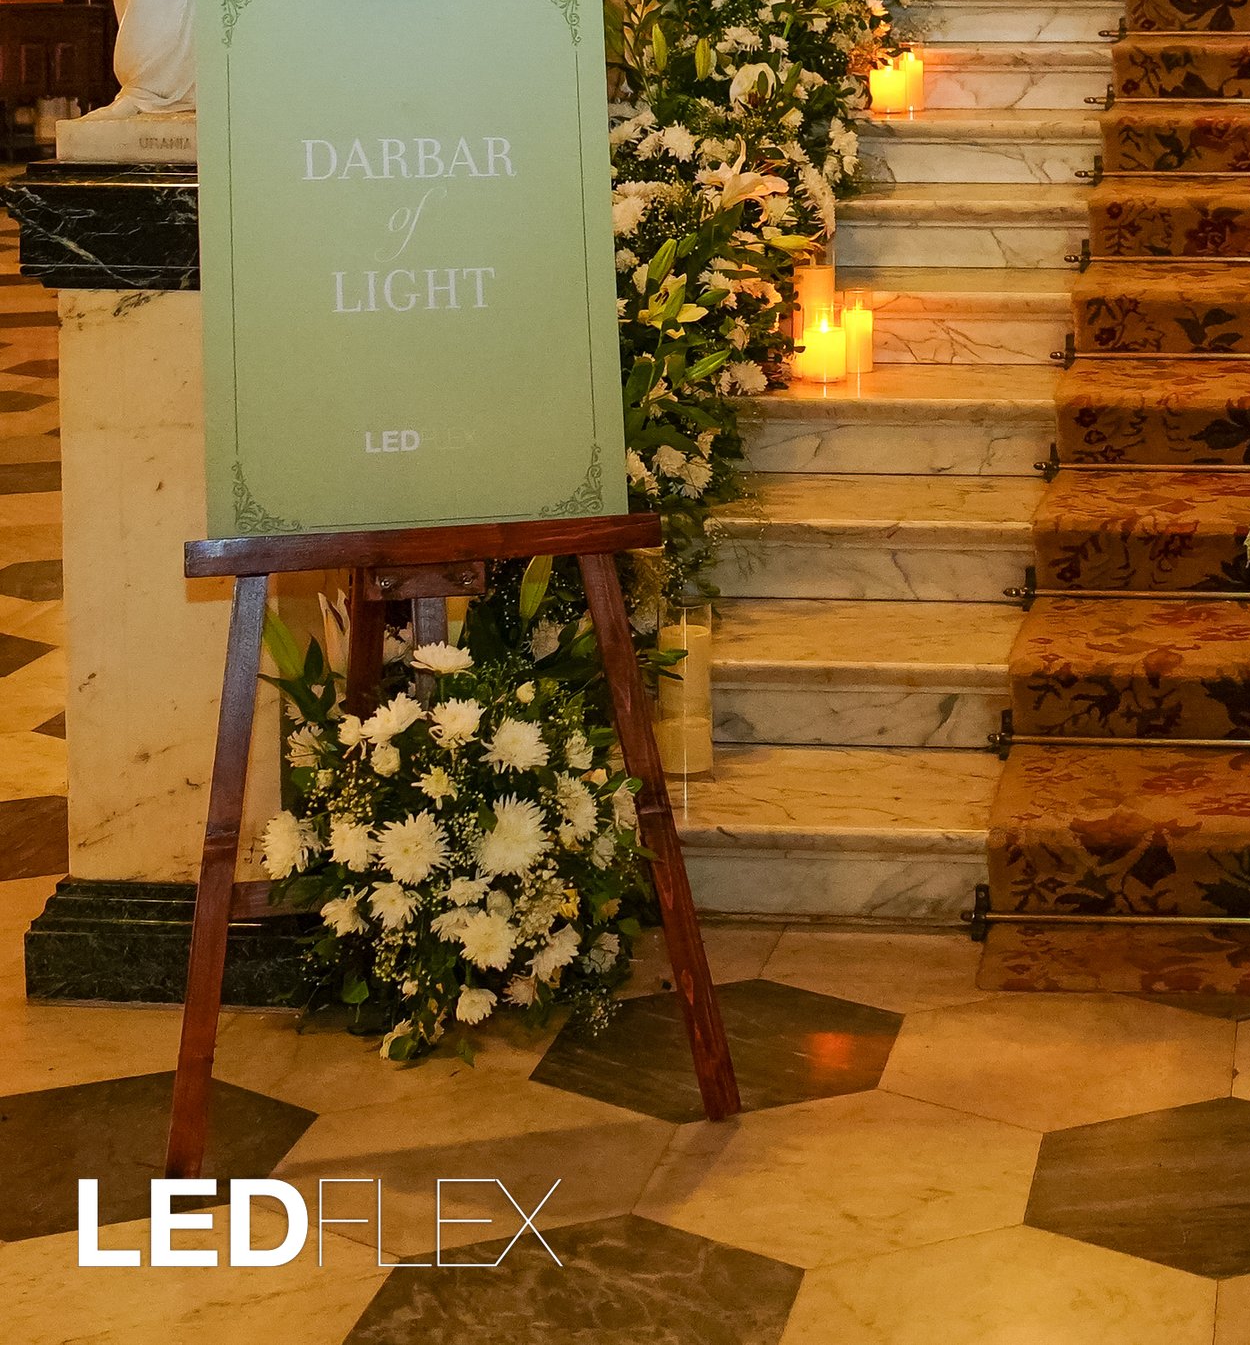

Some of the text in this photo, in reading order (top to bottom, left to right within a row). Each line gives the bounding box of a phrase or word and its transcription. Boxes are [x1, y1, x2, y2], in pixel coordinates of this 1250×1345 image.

[301, 136, 518, 182] DARBAR
[375, 186, 448, 263] of
[331, 266, 496, 314] LIGHT
